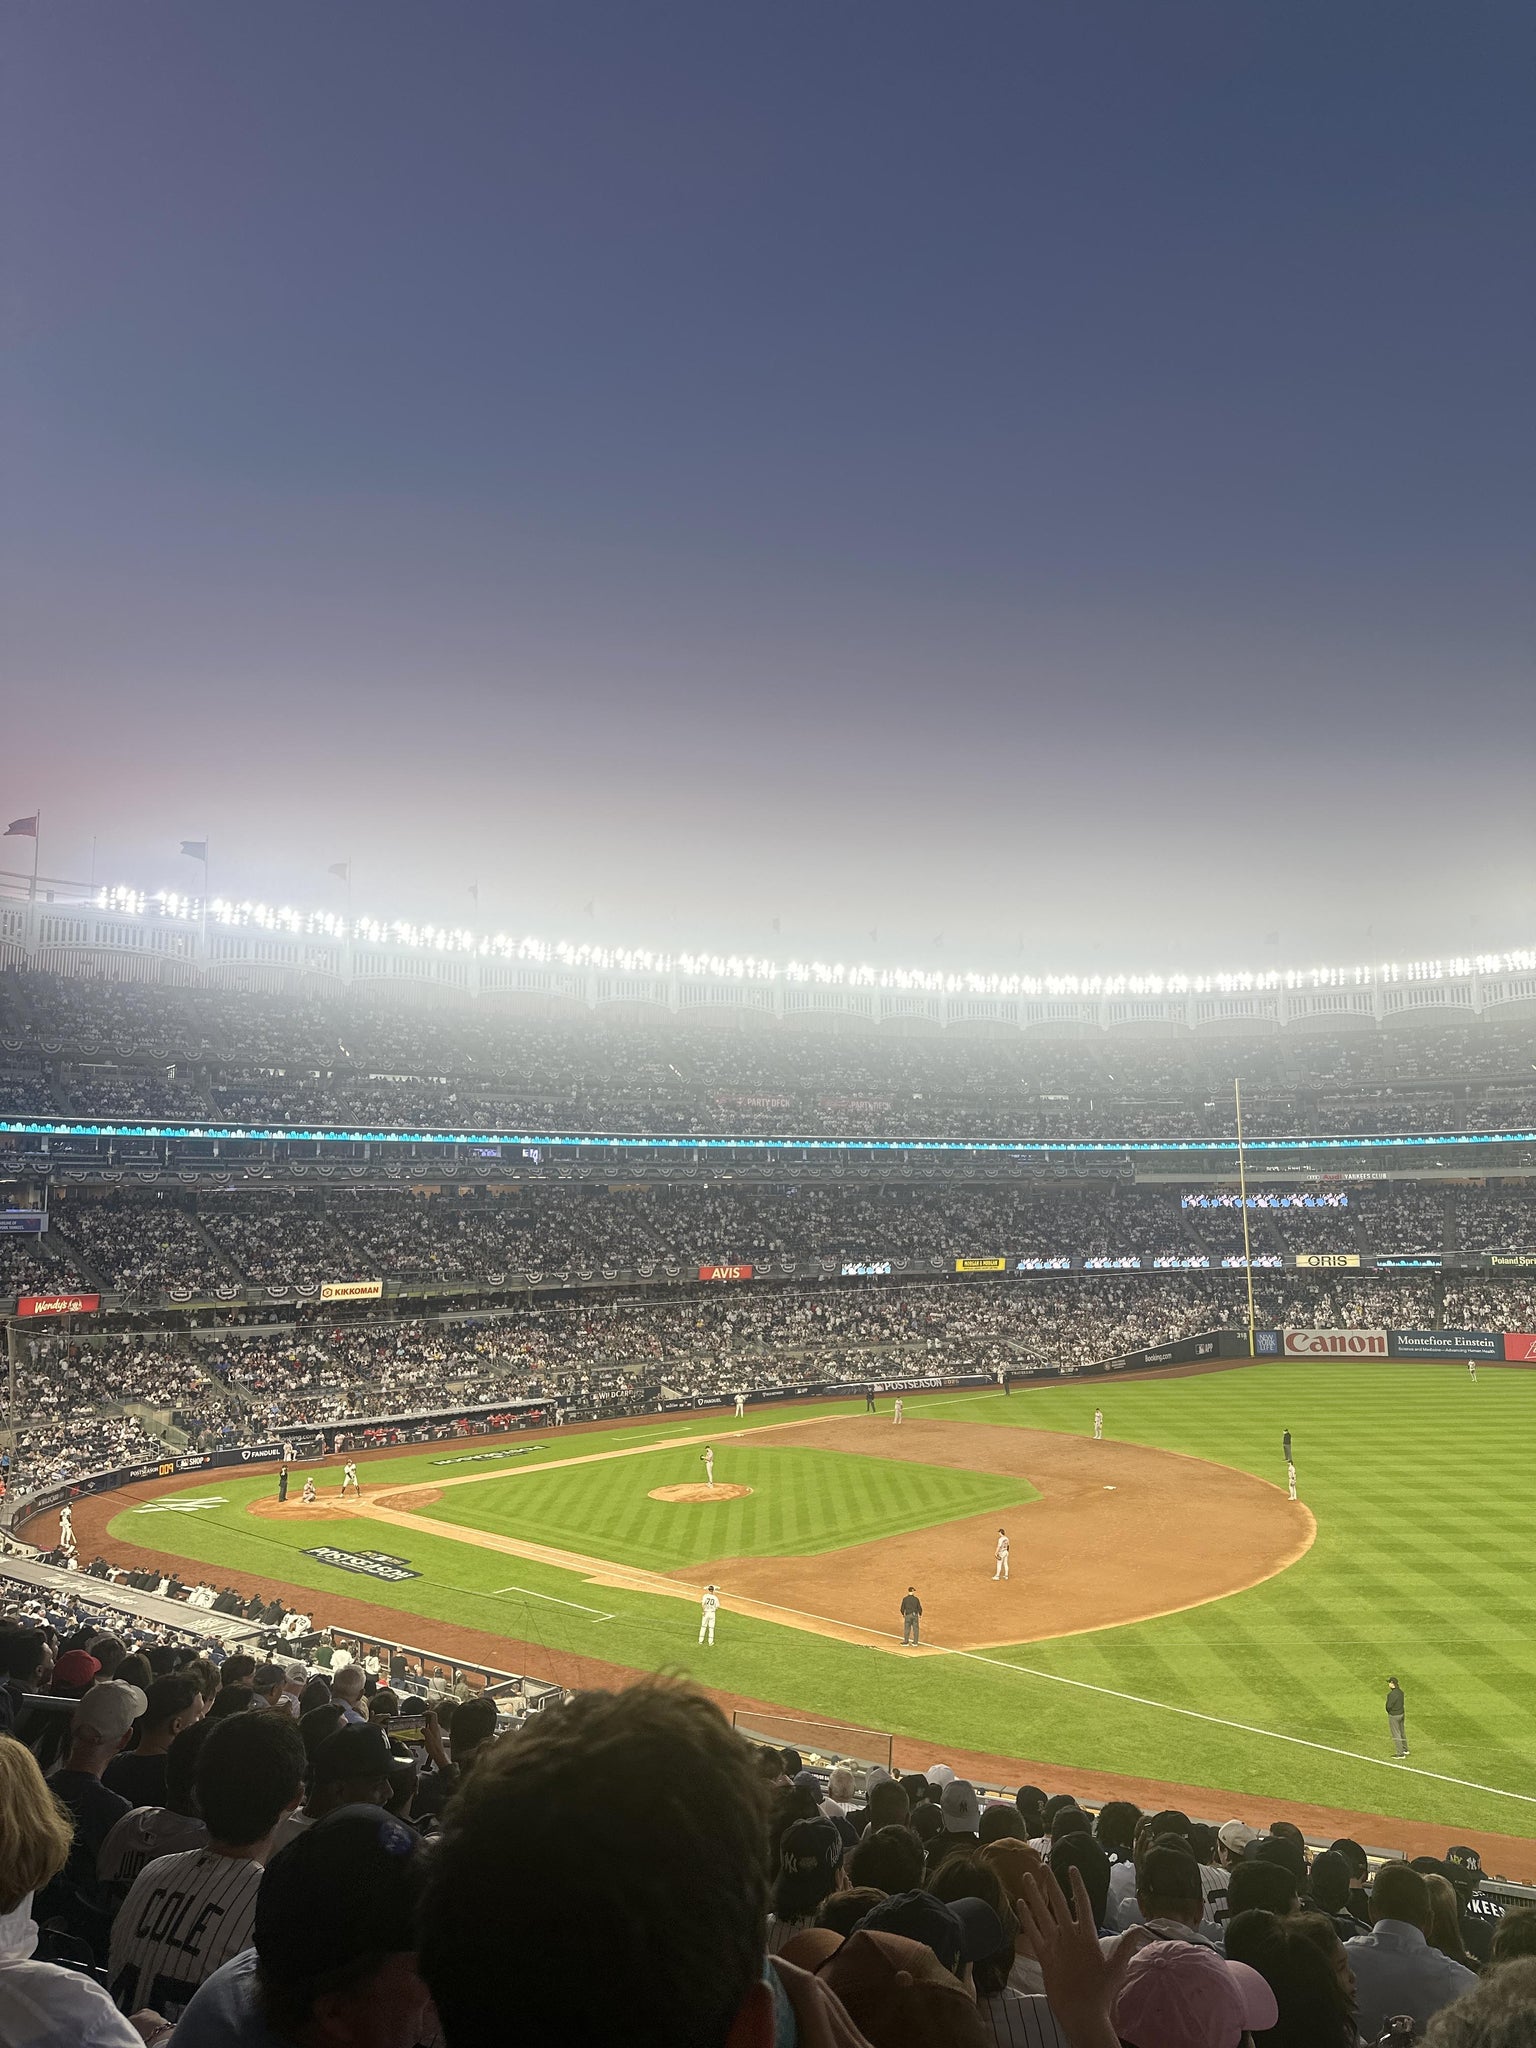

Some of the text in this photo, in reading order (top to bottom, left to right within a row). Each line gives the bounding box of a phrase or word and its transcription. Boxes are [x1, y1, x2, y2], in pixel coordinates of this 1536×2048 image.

[747, 1097, 769, 1107] PARTY
[1307, 1255, 1348, 1267] ORIS
[1491, 1255, 1536, 1267] Poland Spri
[711, 1267, 740, 1279] AVIS
[335, 1287, 379, 1296] KIKKOMAN
[34, 1299, 68, 1314] Wendy's
[1285, 1332, 1386, 1353] Canon
[1397, 1335, 1495, 1347] Montefiore Einstein
[1144, 1352, 1173, 1363] Booking.com
[885, 1378, 942, 1391] POSTSEASON
[251, 1448, 281, 1458] FANDUEL
[189, 1456, 204, 1466] SHOP
[130, 1466, 159, 1477] POSTSEASON
[159, 1462, 174, 1477] 009
[305, 1546, 415, 1581] POSTSEASON
[706, 1597, 715, 1606] 70
[114, 1850, 146, 1881] JUD
[1466, 1898, 1506, 1918] KEES
[135, 1887, 225, 1957] COLE
